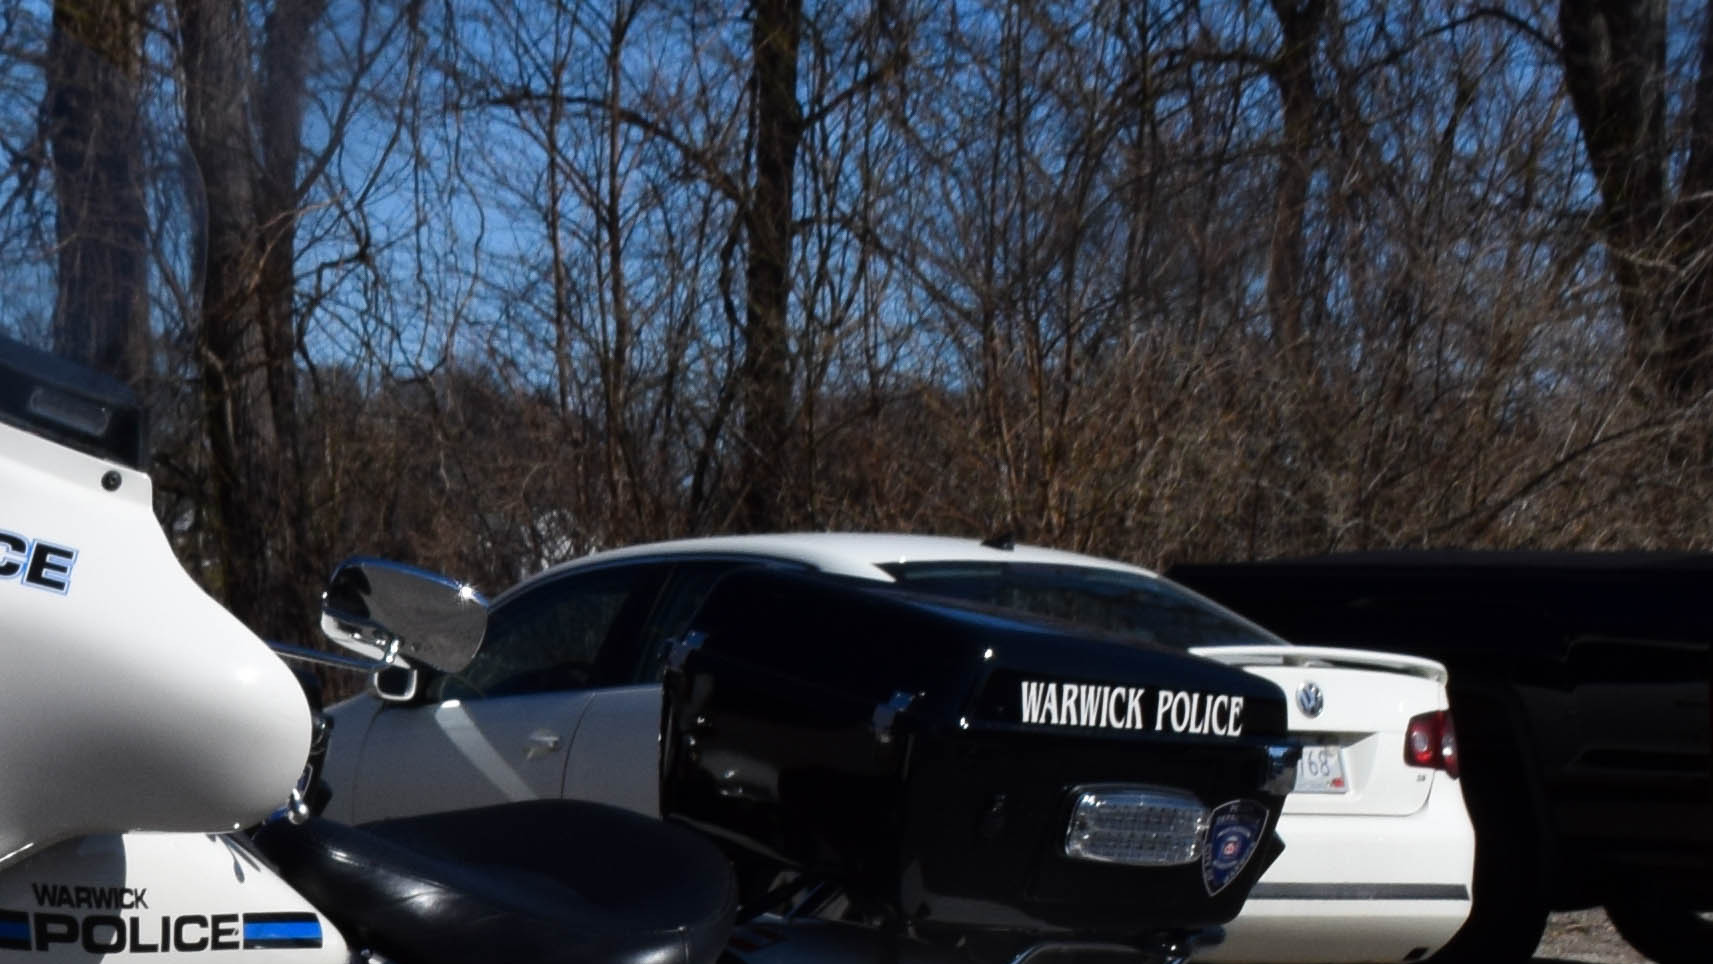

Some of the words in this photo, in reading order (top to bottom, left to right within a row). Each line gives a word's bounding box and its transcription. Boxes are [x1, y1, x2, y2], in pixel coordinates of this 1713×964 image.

[1021, 681, 1144, 729] WARWICK
[1155, 690, 1244, 737] POLICE
[32, 883, 148, 910] WARWICK
[33, 912, 240, 954] POLICE
